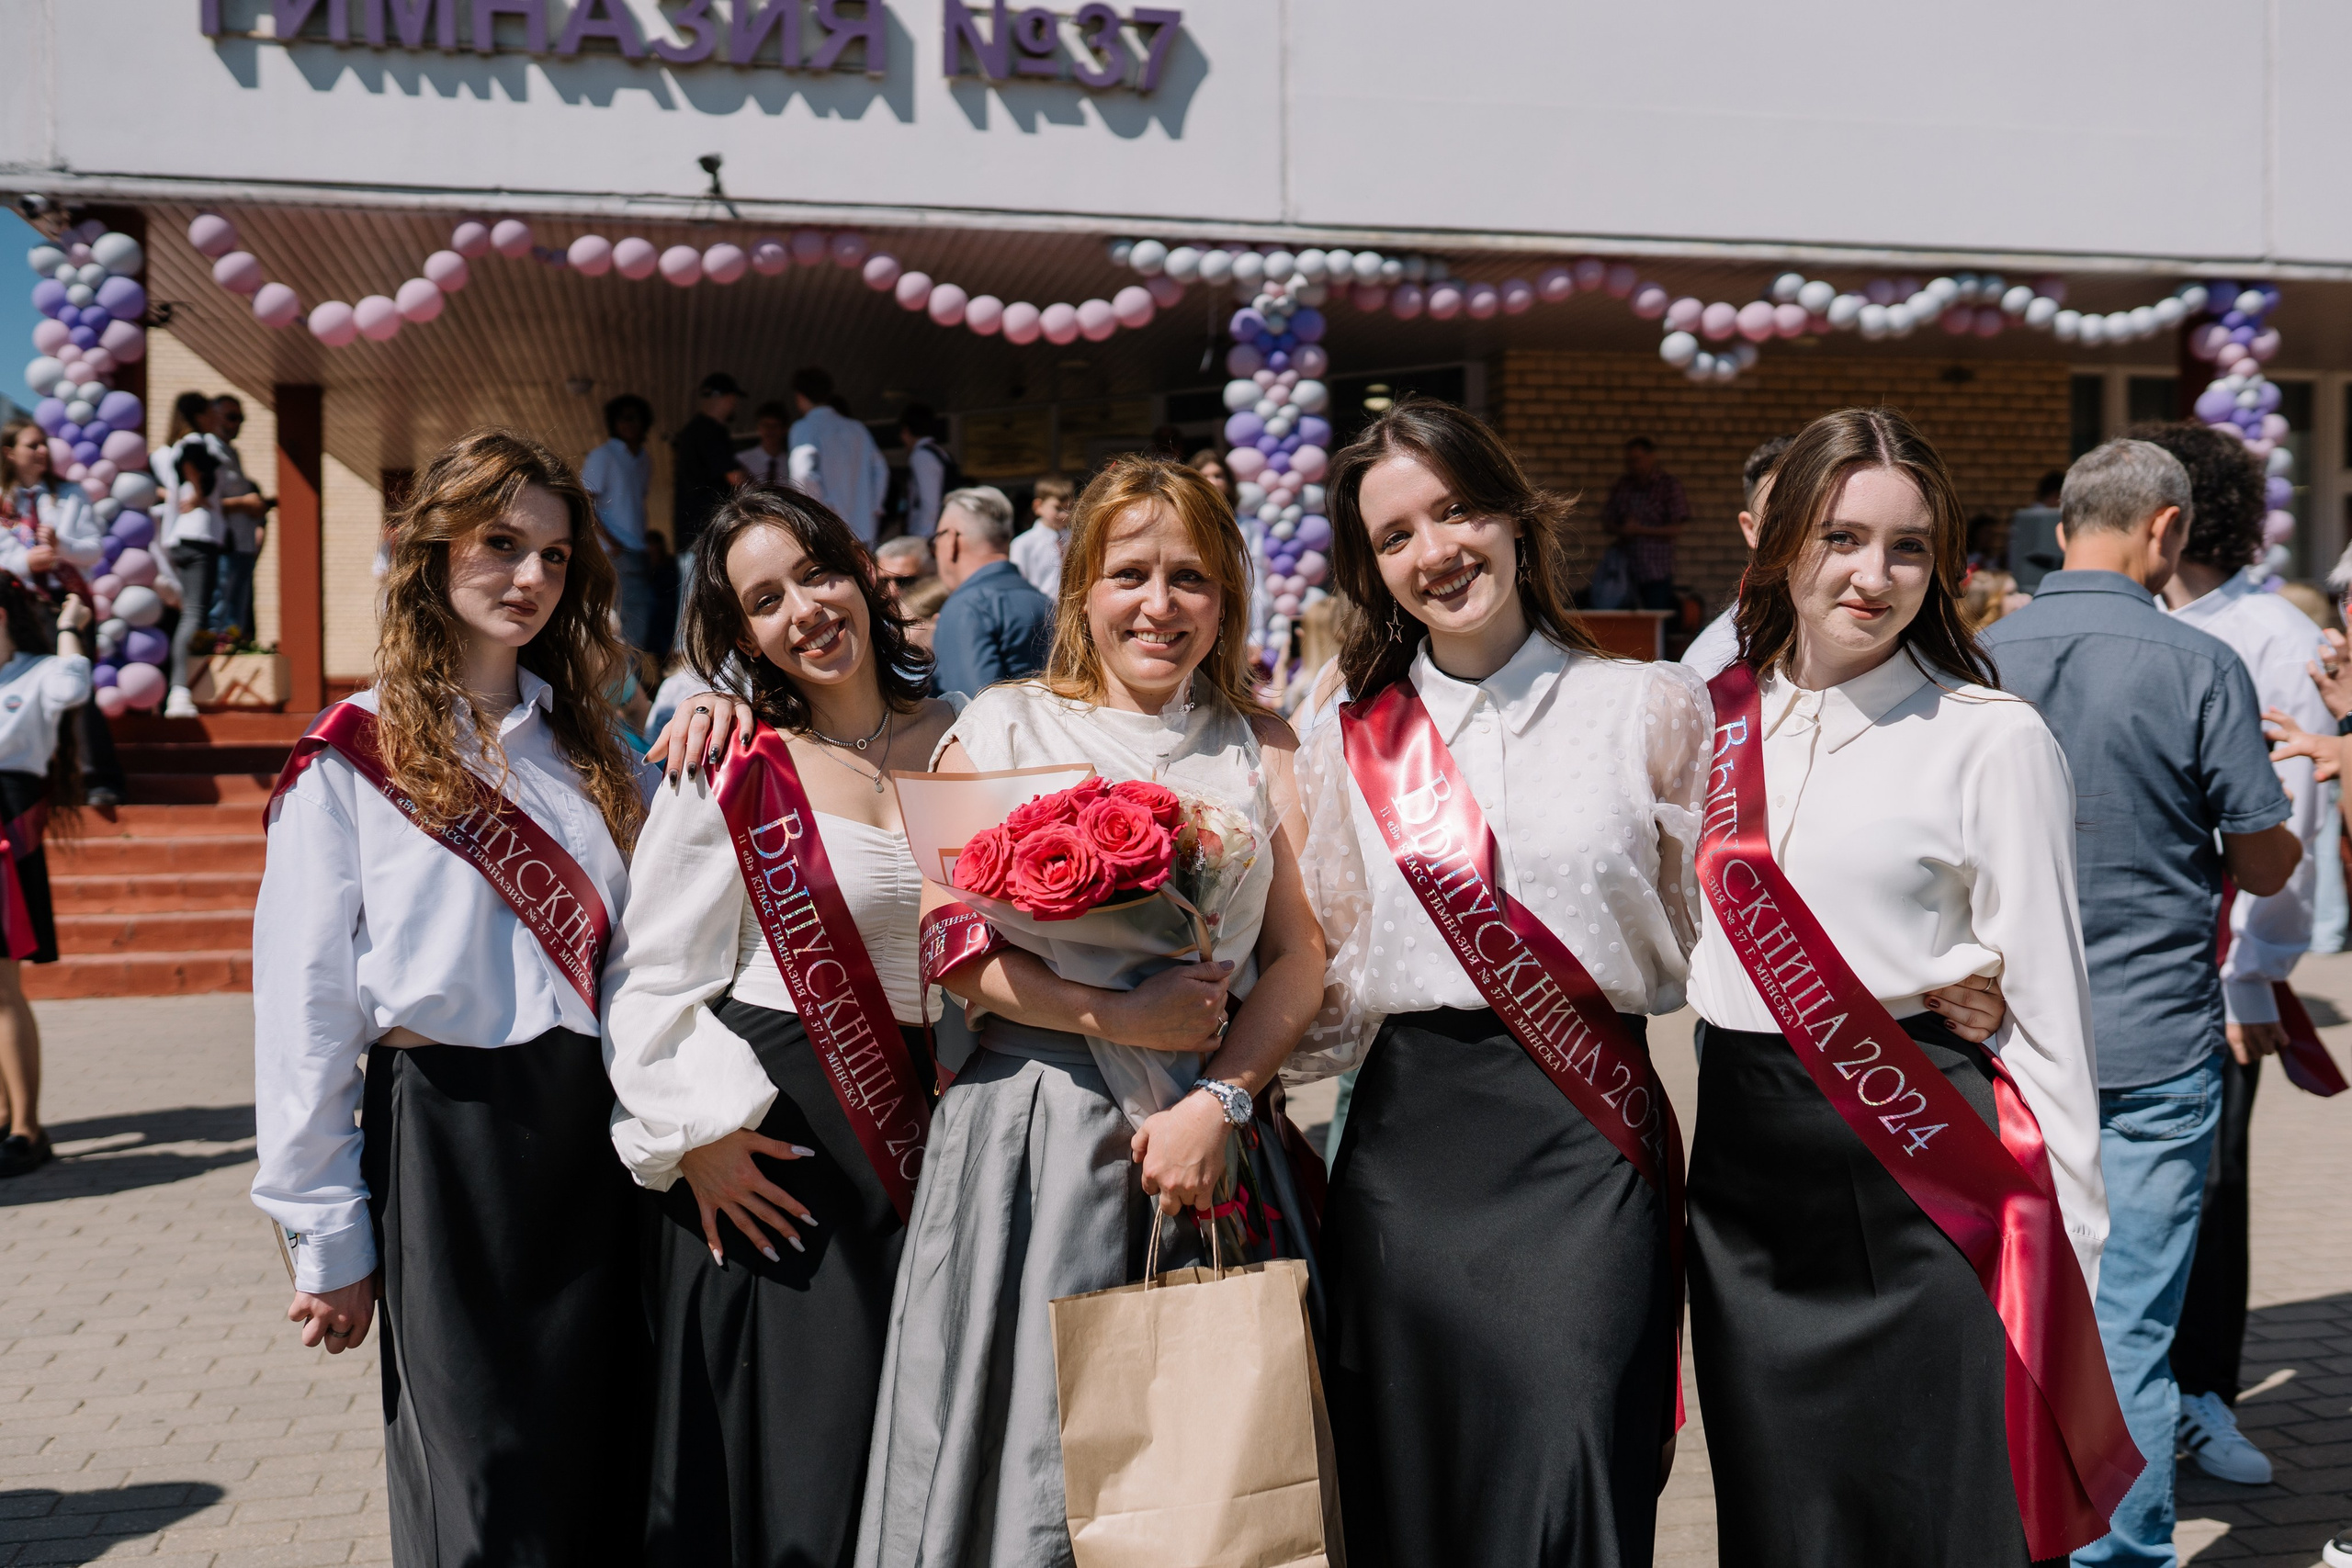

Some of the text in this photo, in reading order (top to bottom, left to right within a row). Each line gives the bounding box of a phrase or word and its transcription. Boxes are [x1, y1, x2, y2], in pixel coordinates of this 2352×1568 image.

[466, 843, 526, 908] ГИМНАЗИЯ
[538, 922, 551, 935] 37
[559, 947, 593, 998] МИНСКА
[737, 833, 748, 845] 11
[751, 874, 775, 919] КЛАСС
[770, 922, 808, 998] ГИМНАЗИЯ
[810, 1020, 824, 1032] 37
[825, 1050, 860, 1108] МИНСКА
[747, 807, 904, 1130] ВЫПУСКНИЦА
[1379, 806, 1391, 818] 11
[1397, 840, 1429, 886] КЛАСС
[1425, 888, 1481, 966] ГИМНАЗИЯ
[1490, 987, 1506, 999] 37
[1514, 1016, 1561, 1072] МИНСКА
[1390, 770, 1603, 1087] ВЫПУСКНИЦА
[1734, 928, 1748, 942] 37
[1753, 961, 1794, 1026] МИНСКА
[1832, 1036, 1950, 1157] 2024
